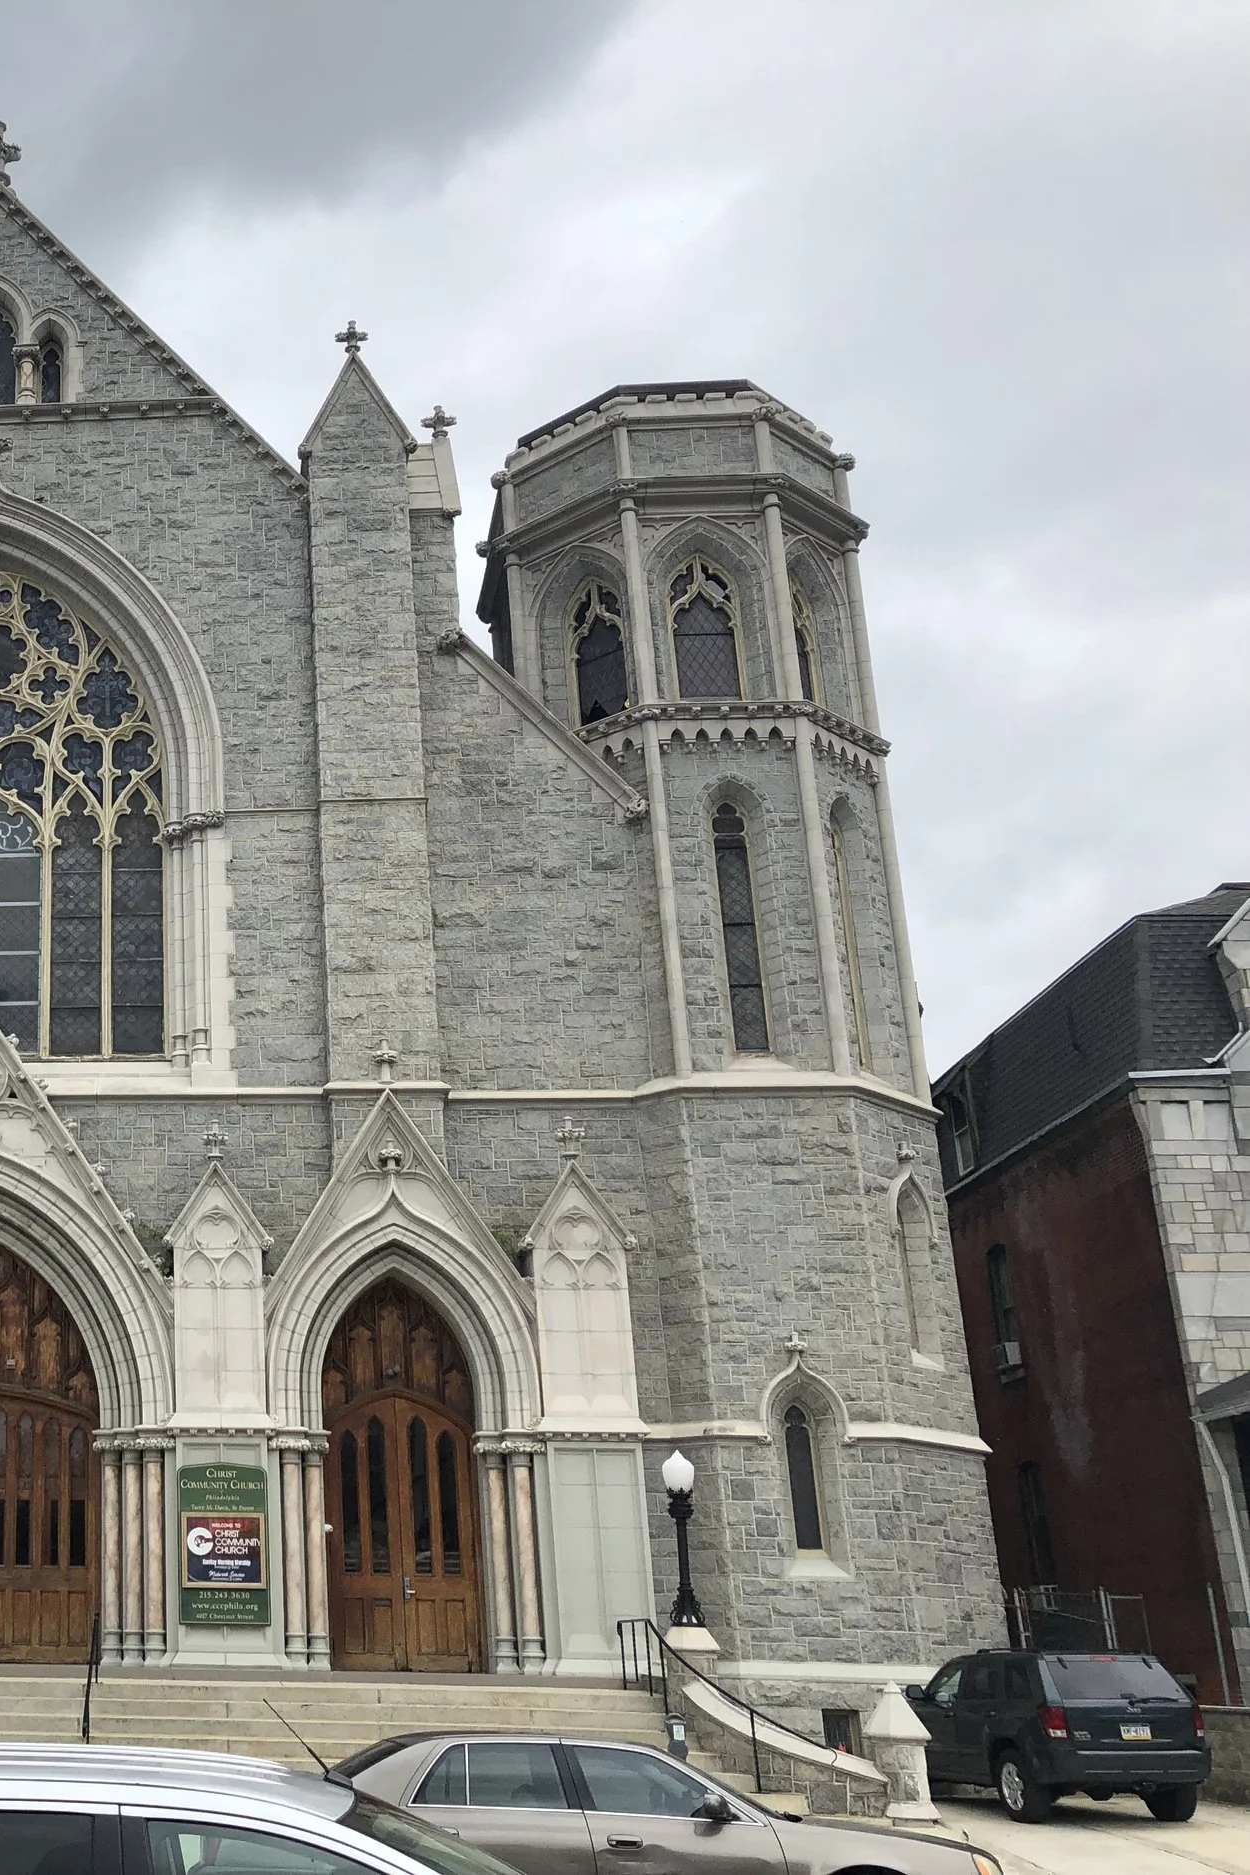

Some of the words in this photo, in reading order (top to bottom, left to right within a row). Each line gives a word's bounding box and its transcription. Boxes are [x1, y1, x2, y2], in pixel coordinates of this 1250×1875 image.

[206, 1468, 237, 1478] CHRIST
[180, 1479, 229, 1489] COMMUNITY
[230, 1480, 264, 1490] CHURCH
[205, 1494, 240, 1502] Philadelphia
[214, 1530, 240, 1538] CHRIST
[214, 1537, 261, 1547] COMMUNITY
[214, 1546, 249, 1555] CHURCH
[198, 1591, 250, 1599] 215.243.3630
[191, 1601, 259, 1612] www.cccphila.org
